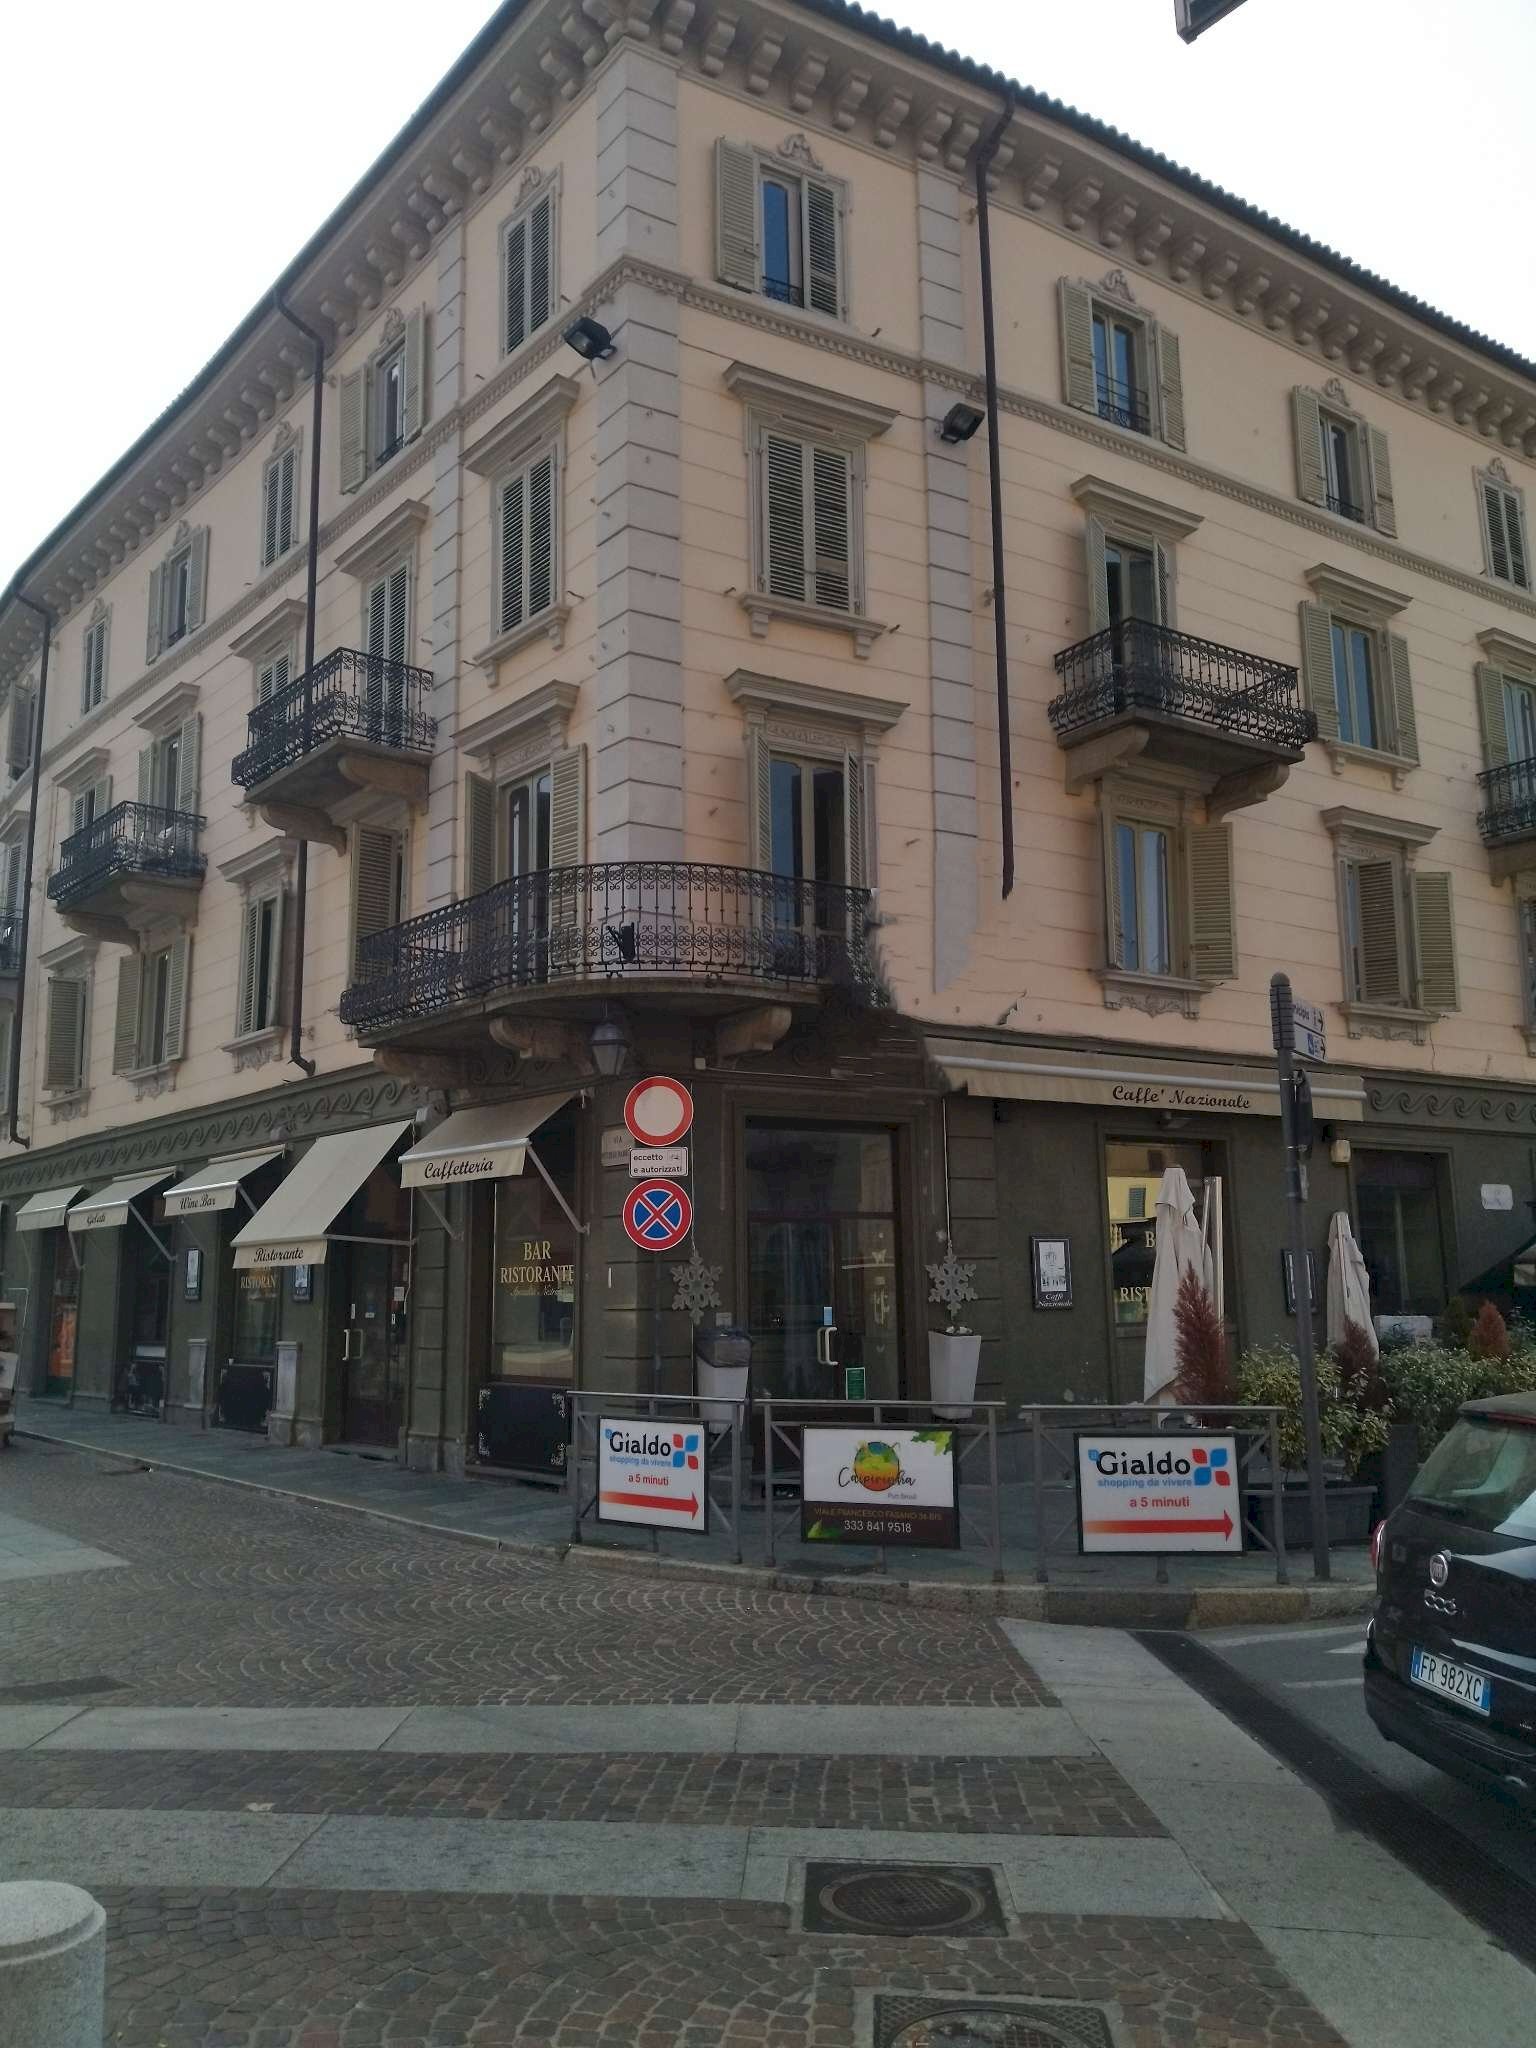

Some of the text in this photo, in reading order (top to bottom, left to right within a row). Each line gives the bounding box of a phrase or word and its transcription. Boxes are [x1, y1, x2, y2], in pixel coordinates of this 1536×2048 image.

[1168, 1089, 1250, 1109] Nazionale
[633, 1153, 663, 1161] eccetto
[424, 1157, 495, 1180] Caffetteria
[180, 1193, 216, 1210] Wine Bar
[253, 1247, 304, 1262] Ristorante
[523, 1240, 551, 1261] BAR
[240, 1275, 276, 1289] RISTORAN
[501, 1264, 574, 1284] RISTORANTE
[609, 1431, 672, 1457] Gialdo
[609, 1455, 671, 1467] shopping da vivere
[1096, 1450, 1191, 1475] Gialdo
[635, 1473, 641, 1482] 5
[642, 1474, 669, 1486] minuti
[1097, 1477, 1192, 1489] shopping da vivere
[1129, 1496, 1190, 1507] a 5 minuti
[844, 1520, 912, 1533] 333 841 9518
[1421, 1655, 1482, 1702] FR 982XC
